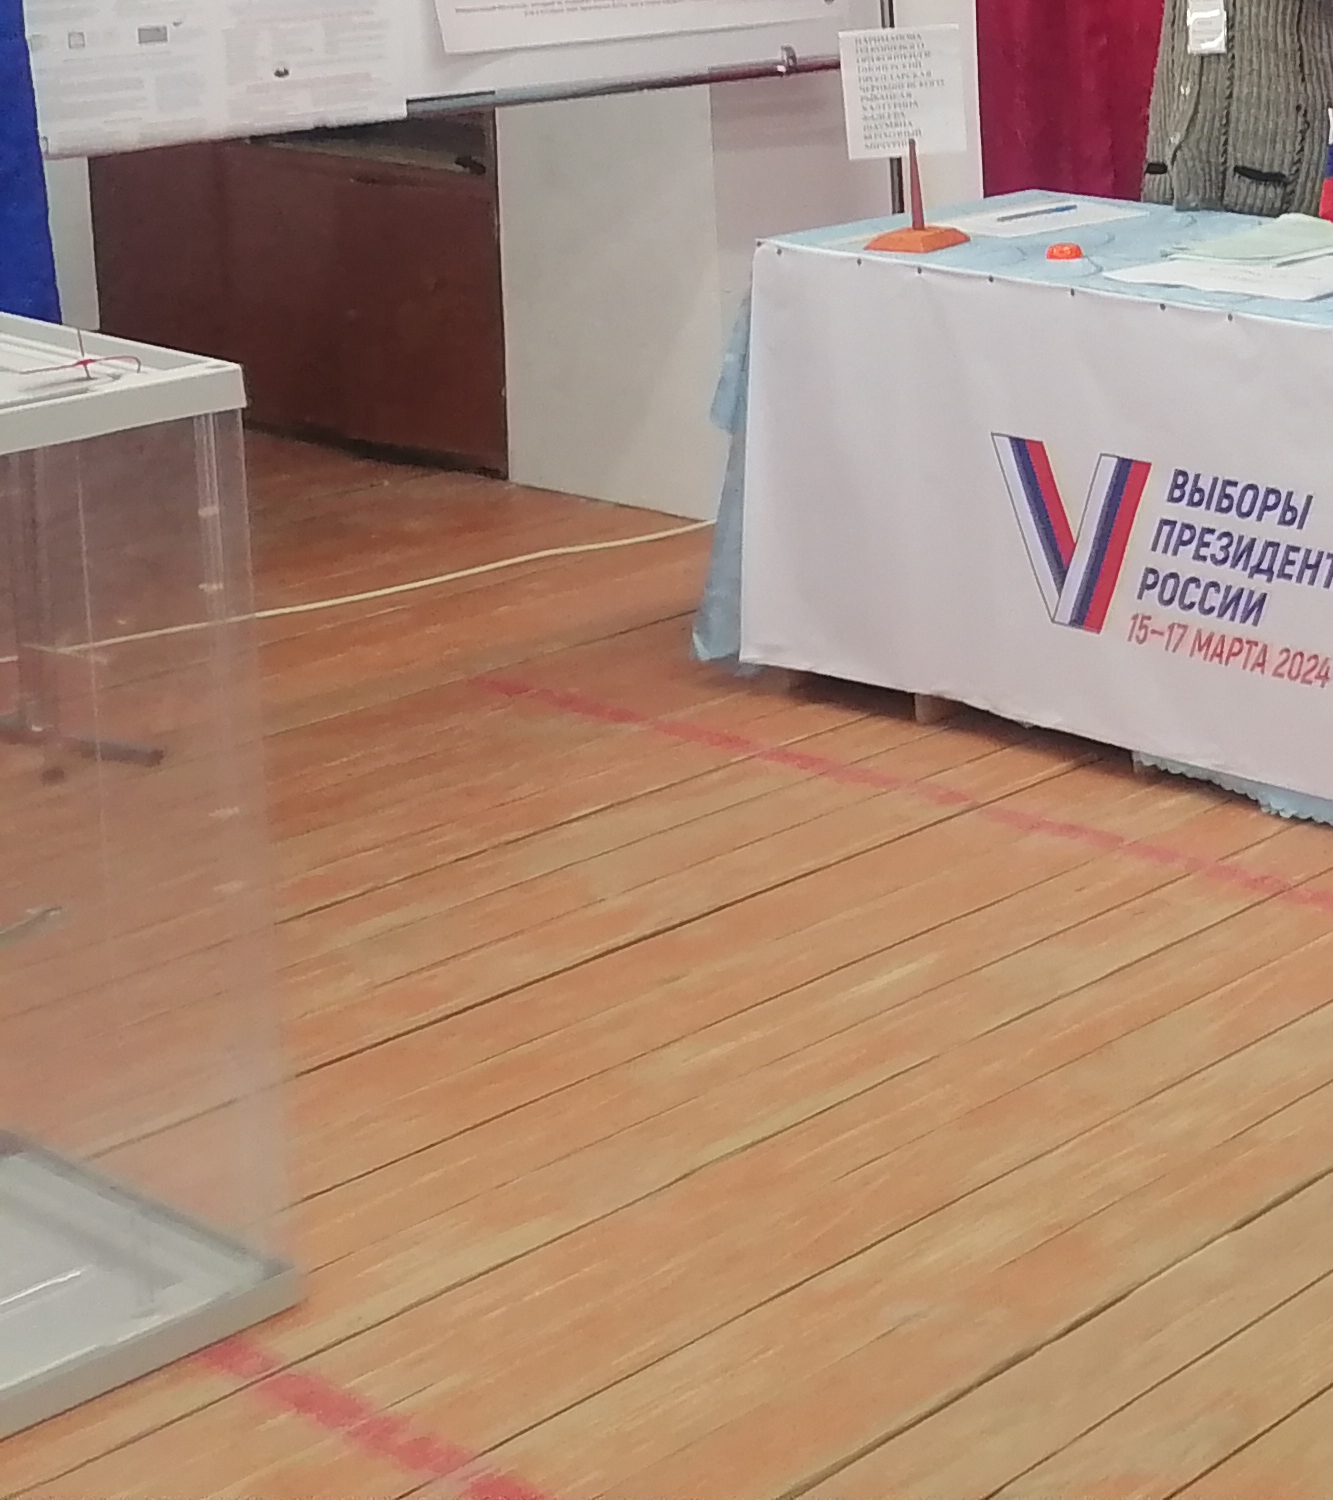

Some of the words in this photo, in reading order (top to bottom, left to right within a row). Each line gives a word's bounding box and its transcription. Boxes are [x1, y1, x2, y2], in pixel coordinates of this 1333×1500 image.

[1166, 468, 1314, 530] ВЫБОРЫ
[1136, 567, 1269, 627] РОССИИ
[1189, 628, 1268, 675] МАРТА
[1271, 647, 1333, 689] 2024
